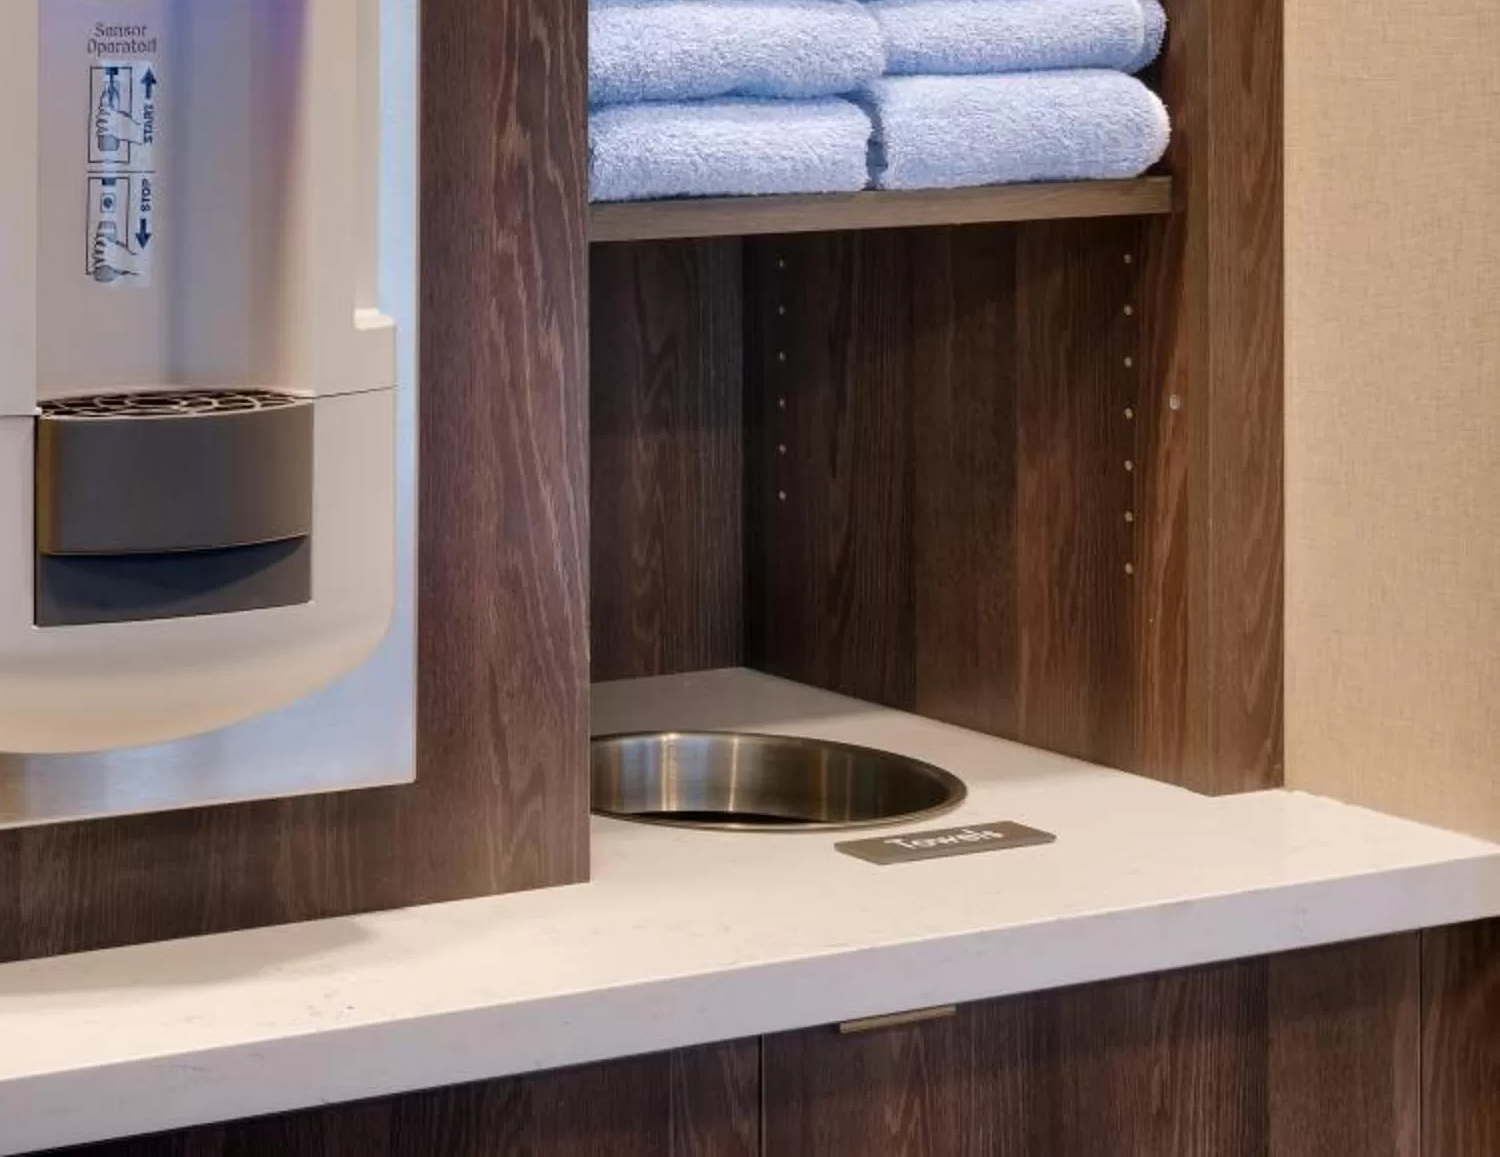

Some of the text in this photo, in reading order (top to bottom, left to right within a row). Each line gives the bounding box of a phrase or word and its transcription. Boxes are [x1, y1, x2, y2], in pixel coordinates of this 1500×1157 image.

[94, 22, 148, 38] Sensor
[143, 104, 155, 144] START
[140, 178, 153, 212] STOP
